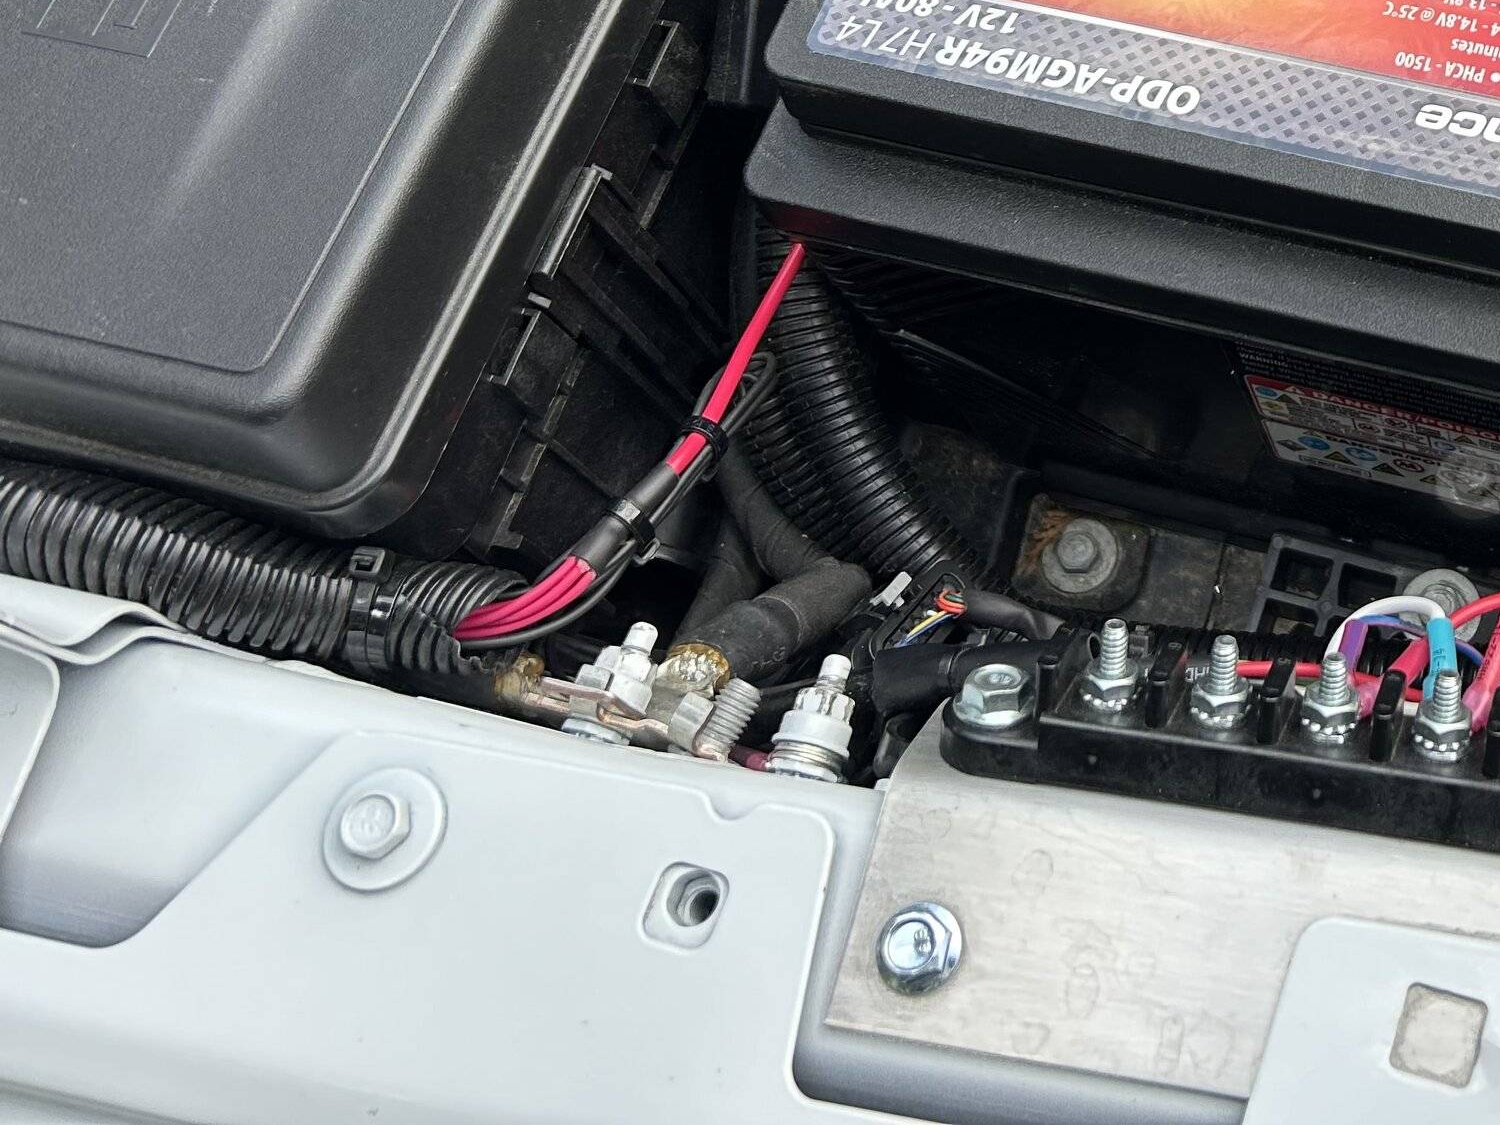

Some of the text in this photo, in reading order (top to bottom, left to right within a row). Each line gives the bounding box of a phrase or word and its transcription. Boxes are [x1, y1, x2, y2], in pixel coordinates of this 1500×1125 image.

[952, 0, 1021, 36] 12V
[1382, 0, 1419, 20] 25°C
[1434, 10, 1479, 33] 14.8V
[833, 12, 1201, 118] ODP-AGM94R H7 L4
[1393, 49, 1433, 72] 1500
[1442, 59, 1486, 83] PHCA
